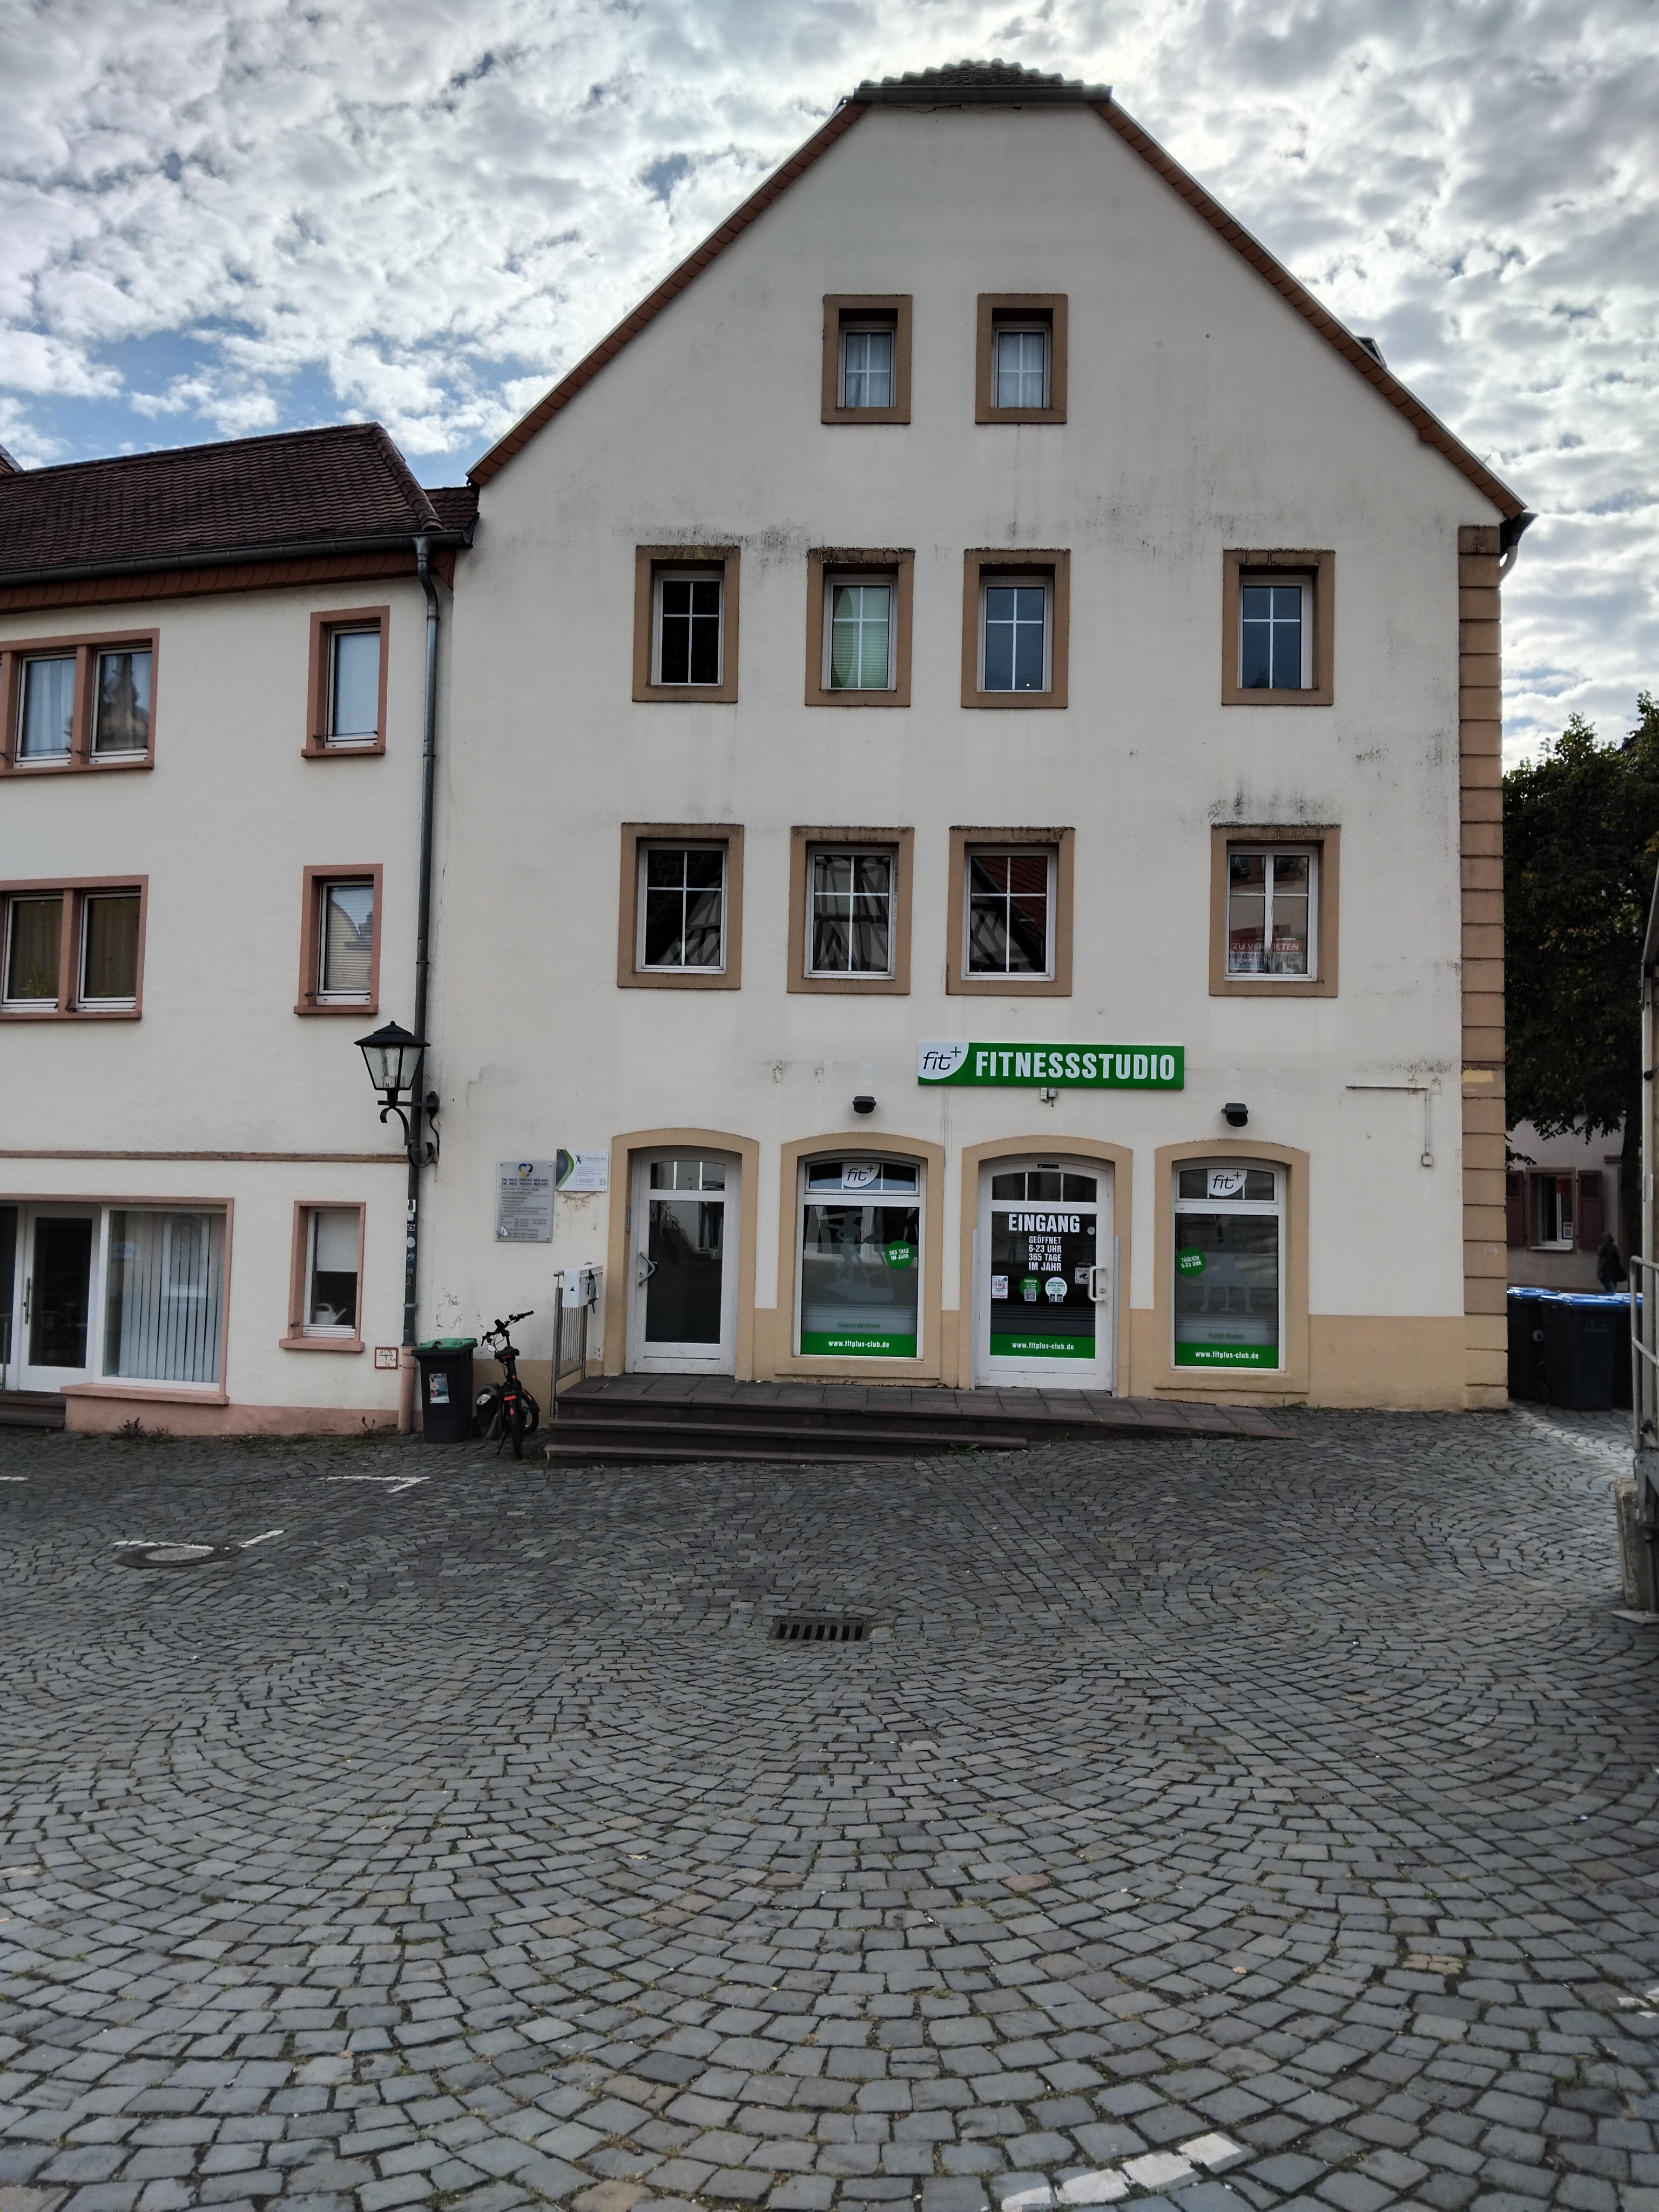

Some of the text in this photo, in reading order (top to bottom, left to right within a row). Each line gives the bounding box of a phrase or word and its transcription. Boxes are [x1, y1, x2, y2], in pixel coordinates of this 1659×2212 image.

[976, 1051, 1175, 1081] FITNESSSTUDIO
[1008, 1213, 1080, 1233] EINGANG
[1028, 1235, 1062, 1244] GEÖFFNET
[1028, 1244, 1062, 1253] 6-23 UHR
[1028, 1253, 1062, 1262] 365 TAGE
[1181, 1255, 1200, 1263] TÄGLICH
[1028, 1262, 1062, 1271] IM JAHR
[828, 1340, 890, 1348] www.fitplus-club.de
[1011, 1342, 1074, 1350] www.fitplus-club.de
[1195, 1351, 1259, 1359] www.fitplus-club.de
